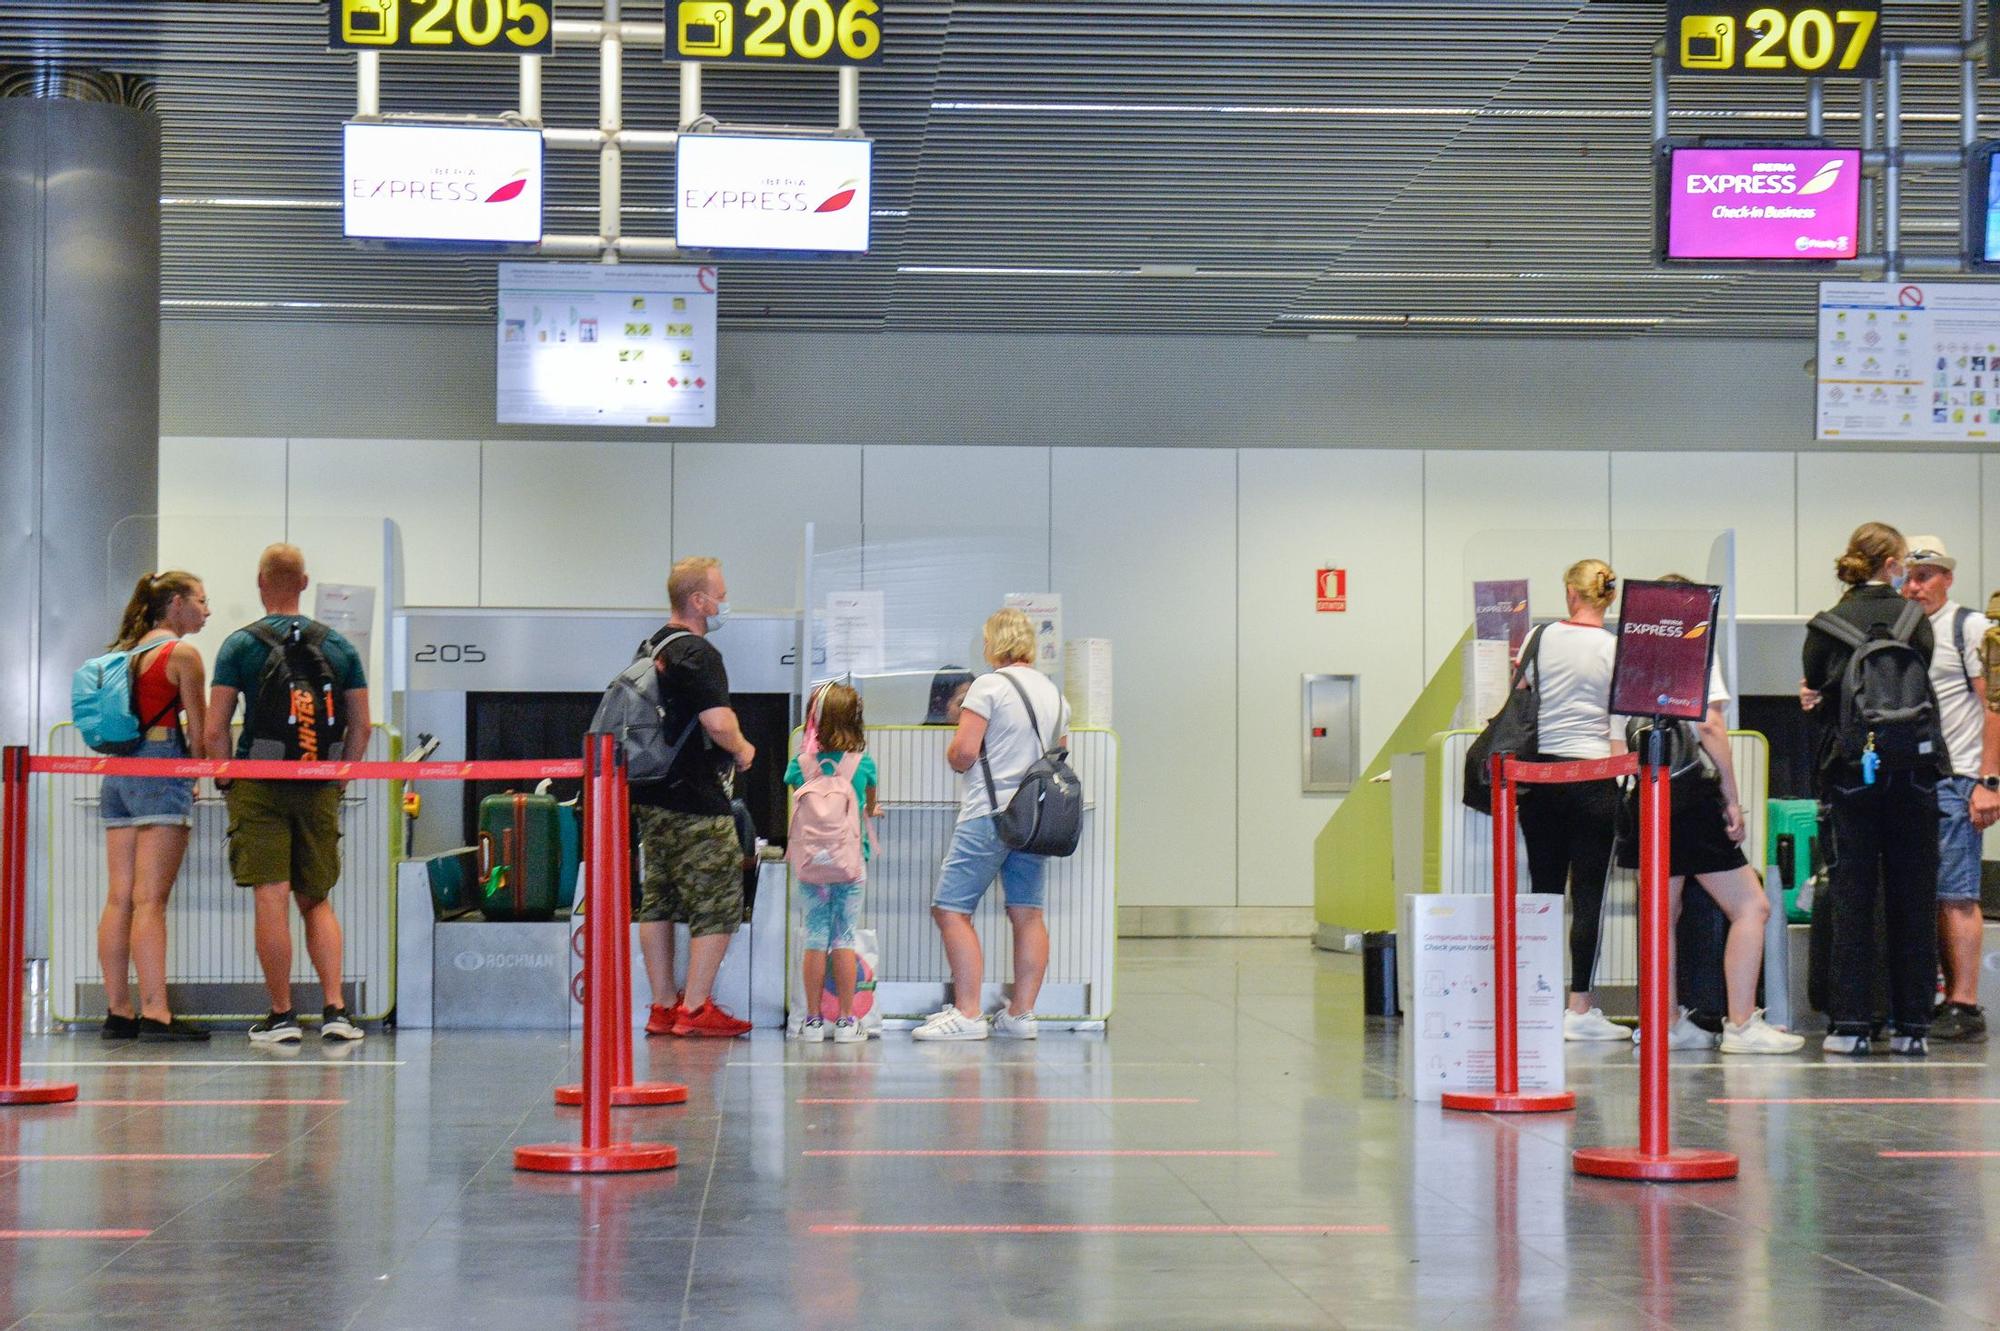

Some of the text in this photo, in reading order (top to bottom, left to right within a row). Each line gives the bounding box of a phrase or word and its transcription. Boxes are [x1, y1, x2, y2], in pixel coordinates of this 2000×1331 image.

[410, 0, 549, 46] 205
[744, 0, 880, 59] 206
[1745, 8, 1878, 70] 207
[353, 179, 478, 201] EXPRESS
[1686, 174, 1797, 194] EXPRESS
[686, 190, 808, 212] EXPRESS
[1624, 622, 1684, 638] EXPRESS
[415, 644, 486, 663] 205
